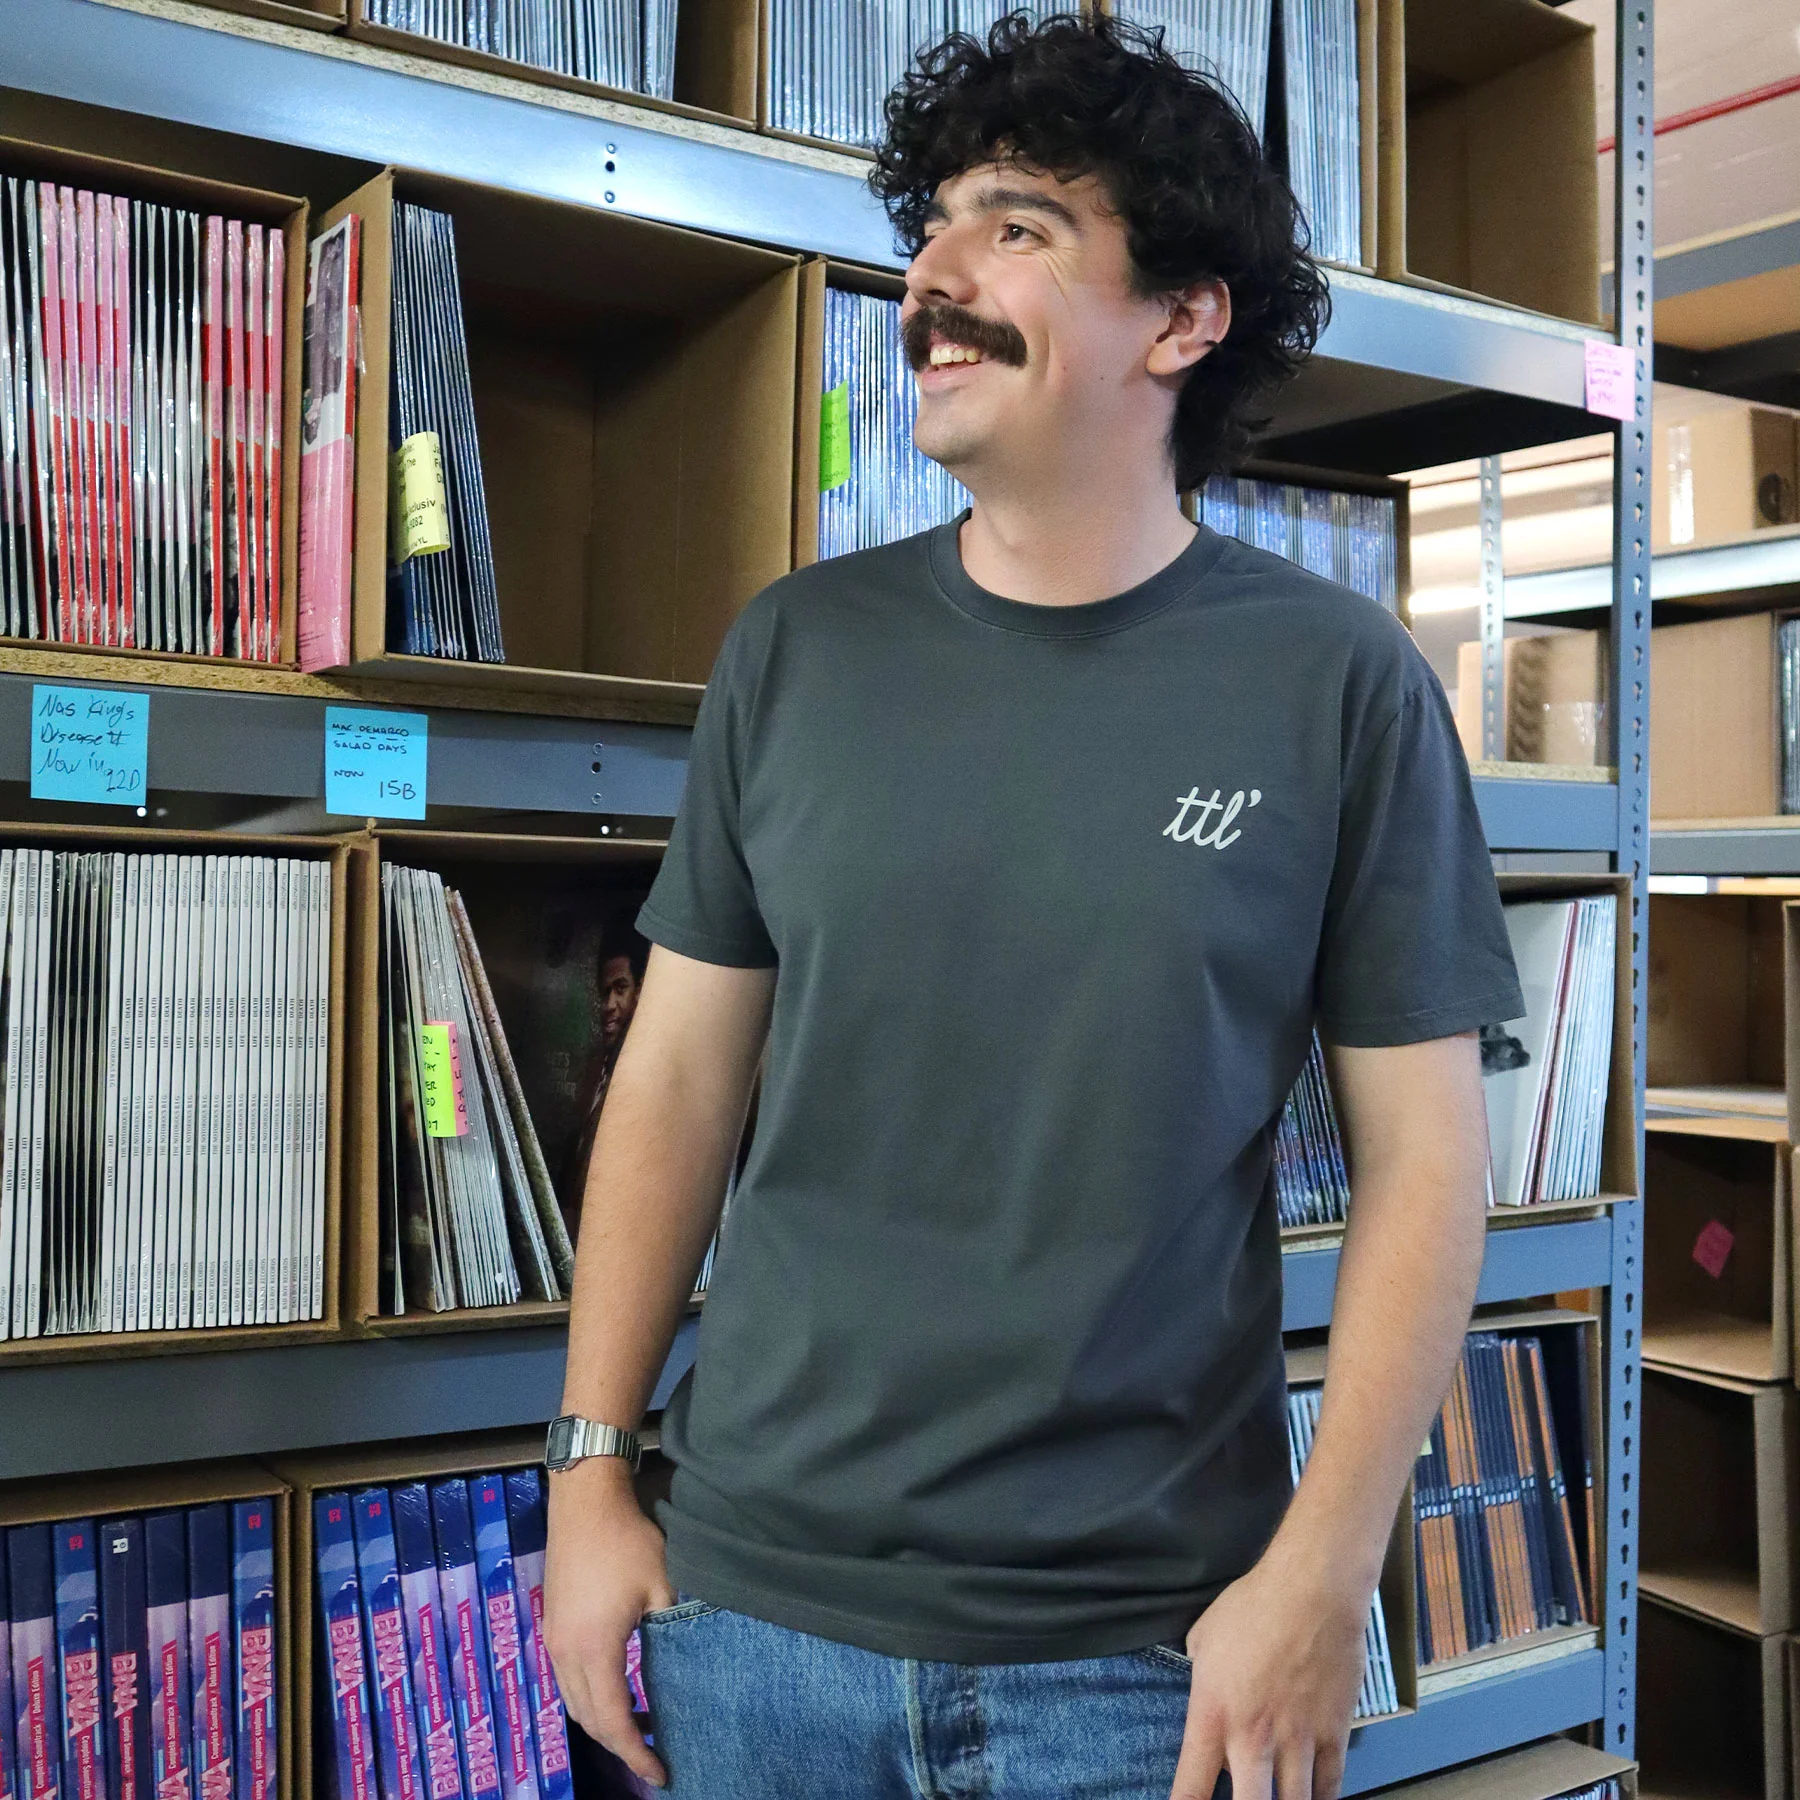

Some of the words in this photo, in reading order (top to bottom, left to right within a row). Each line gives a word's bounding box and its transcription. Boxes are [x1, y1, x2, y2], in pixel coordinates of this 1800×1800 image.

[39, 695, 76, 717] Nas
[332, 723, 352, 731] MAC
[359, 725, 409, 737] DEMARCO
[333, 740, 372, 750] SALAD
[378, 744, 408, 754] DAYS
[37, 748, 81, 775] Now
[334, 770, 364, 778] NOW
[379, 780, 416, 800] 15B
[423, 1616, 431, 1636] Edition
[461, 1612, 469, 1631] Edition
[425, 1637, 433, 1656] Deluxe
[464, 1632, 472, 1650] Deluxe
[165, 1654, 174, 1675] Edition
[209, 1645, 217, 1666] Edition
[538, 1645, 548, 1674] Soundtrack
[31, 1670, 41, 1692] Edition
[166, 1676, 174, 1696] Deluxe
[209, 1667, 217, 1687] Deluxe
[428, 1664, 437, 1696] Soundtrack
[466, 1660, 477, 1691] Soundtrack
[506, 1668, 515, 1694] Complete
[542, 1675, 551, 1701] Complete
[32, 1693, 41, 1714] Deluxe
[349, 1695, 357, 1722] Complete
[392, 1687, 401, 1713] Complete
[431, 1696, 441, 1723] Complete
[470, 1690, 479, 1717] Complete
[509, 1694, 518, 1724] Soundtrack
[167, 1707, 176, 1741] Soundtrack
[210, 1697, 219, 1730] Soundtrack
[254, 1708, 263, 1735] Complete
[33, 1724, 42, 1759] Soundtrack
[123, 1716, 132, 1743] Complete
[351, 1723, 361, 1755] Soundtrack
[395, 1714, 405, 1746] Soundtrack
[81, 1736, 90, 1764] Complete
[168, 1741, 177, 1769] Complete
[211, 1731, 219, 1759] Complete
[255, 1737, 264, 1770] Soundtrack
[513, 1734, 521, 1752] Deluxe
[36, 1760, 45, 1789] Complete
[400, 1755, 408, 1774] Deluxe
[516, 1752, 524, 1772] Edition
[83, 1765, 92, 1800] Soundtrack
